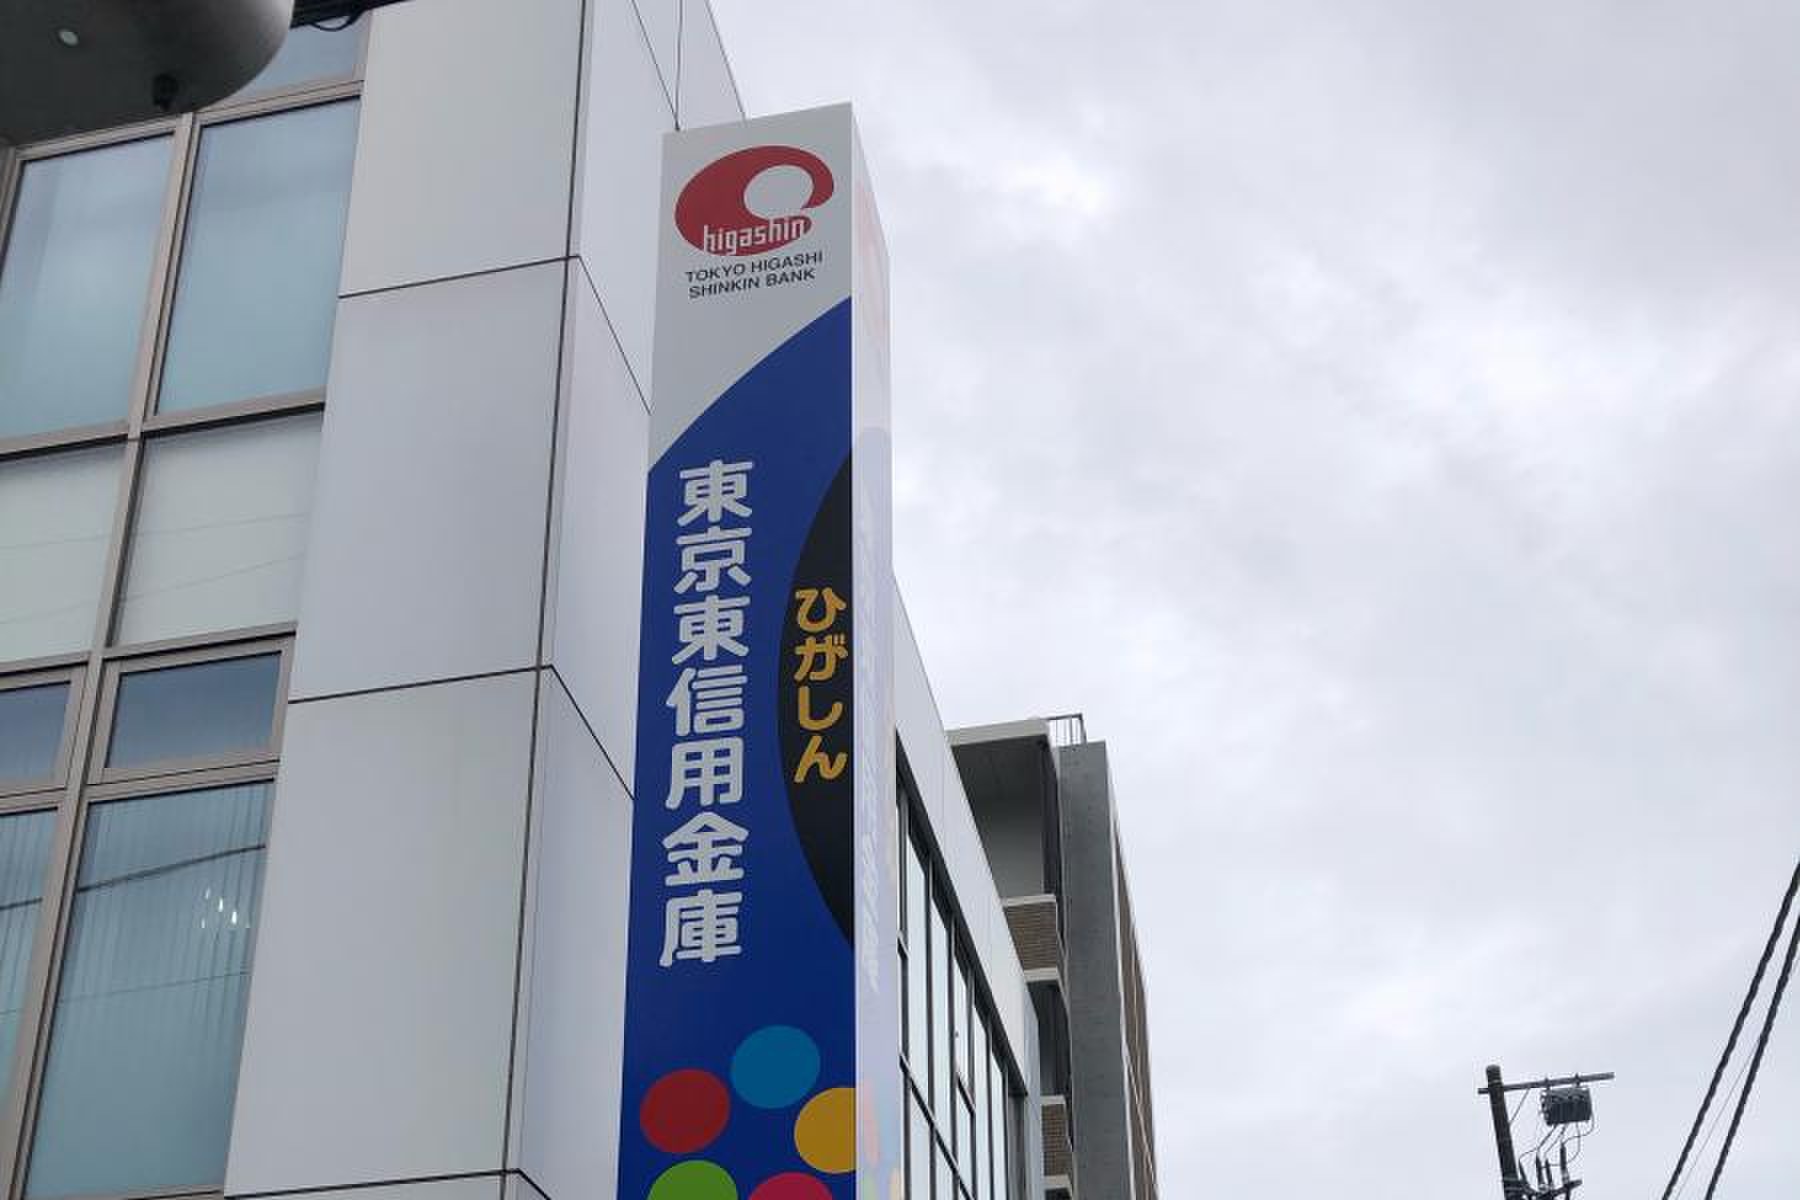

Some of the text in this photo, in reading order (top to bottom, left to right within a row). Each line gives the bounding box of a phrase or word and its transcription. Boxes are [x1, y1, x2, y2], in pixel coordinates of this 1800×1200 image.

[703, 216, 807, 255] higashin
[685, 251, 823, 284] TOKYO HIGASHI
[688, 268, 817, 299] SHINKIN BANK
[794, 586, 848, 784] ひがしん
[659, 459, 754, 968] 東京東信用金庫
